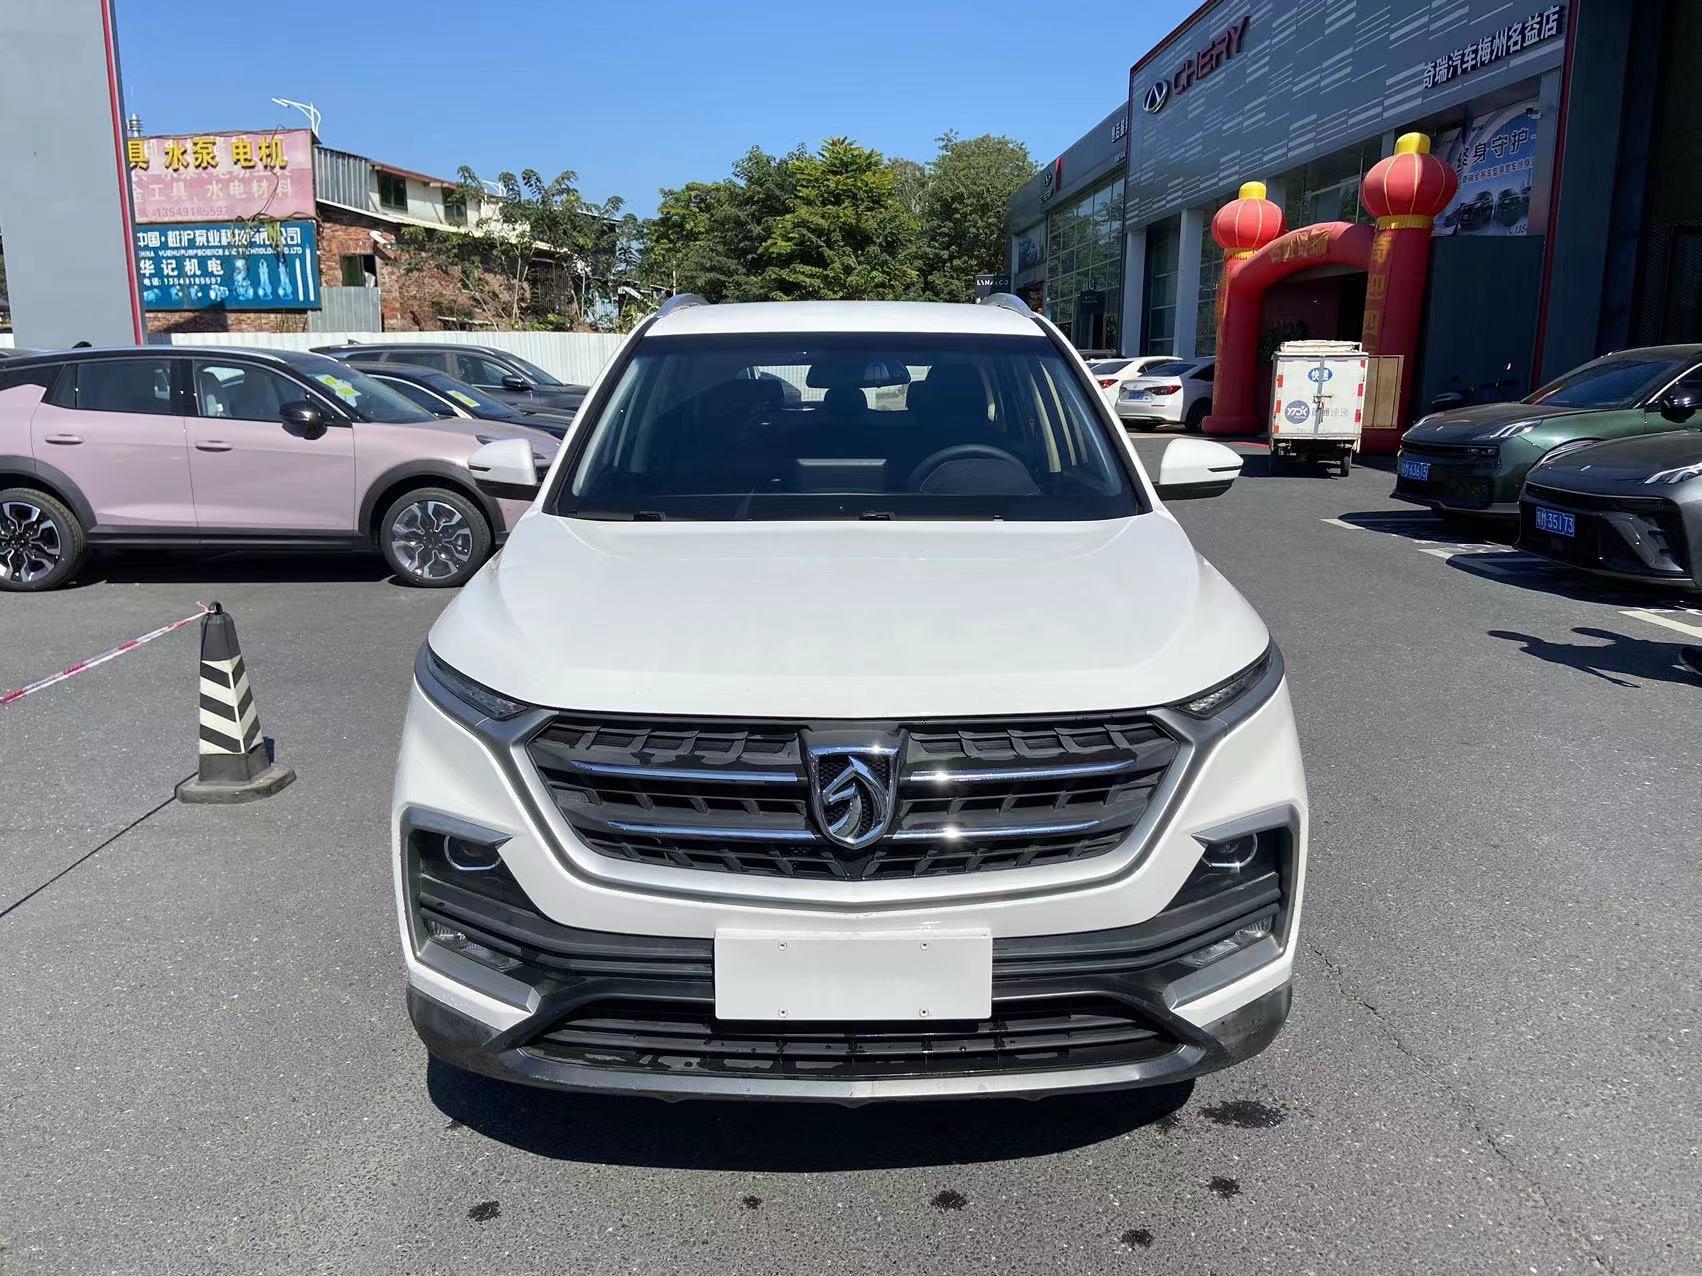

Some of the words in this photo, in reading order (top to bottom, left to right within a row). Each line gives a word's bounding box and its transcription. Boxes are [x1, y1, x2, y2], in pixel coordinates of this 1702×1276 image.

[1173, 16, 1251, 94] CHERY
[1423, 5, 1560, 88] 奇瑞汽车梅州名益店
[164, 136, 218, 170] 水泵
[231, 136, 288, 169] 电机
[140, 258, 224, 277] 华记机电
